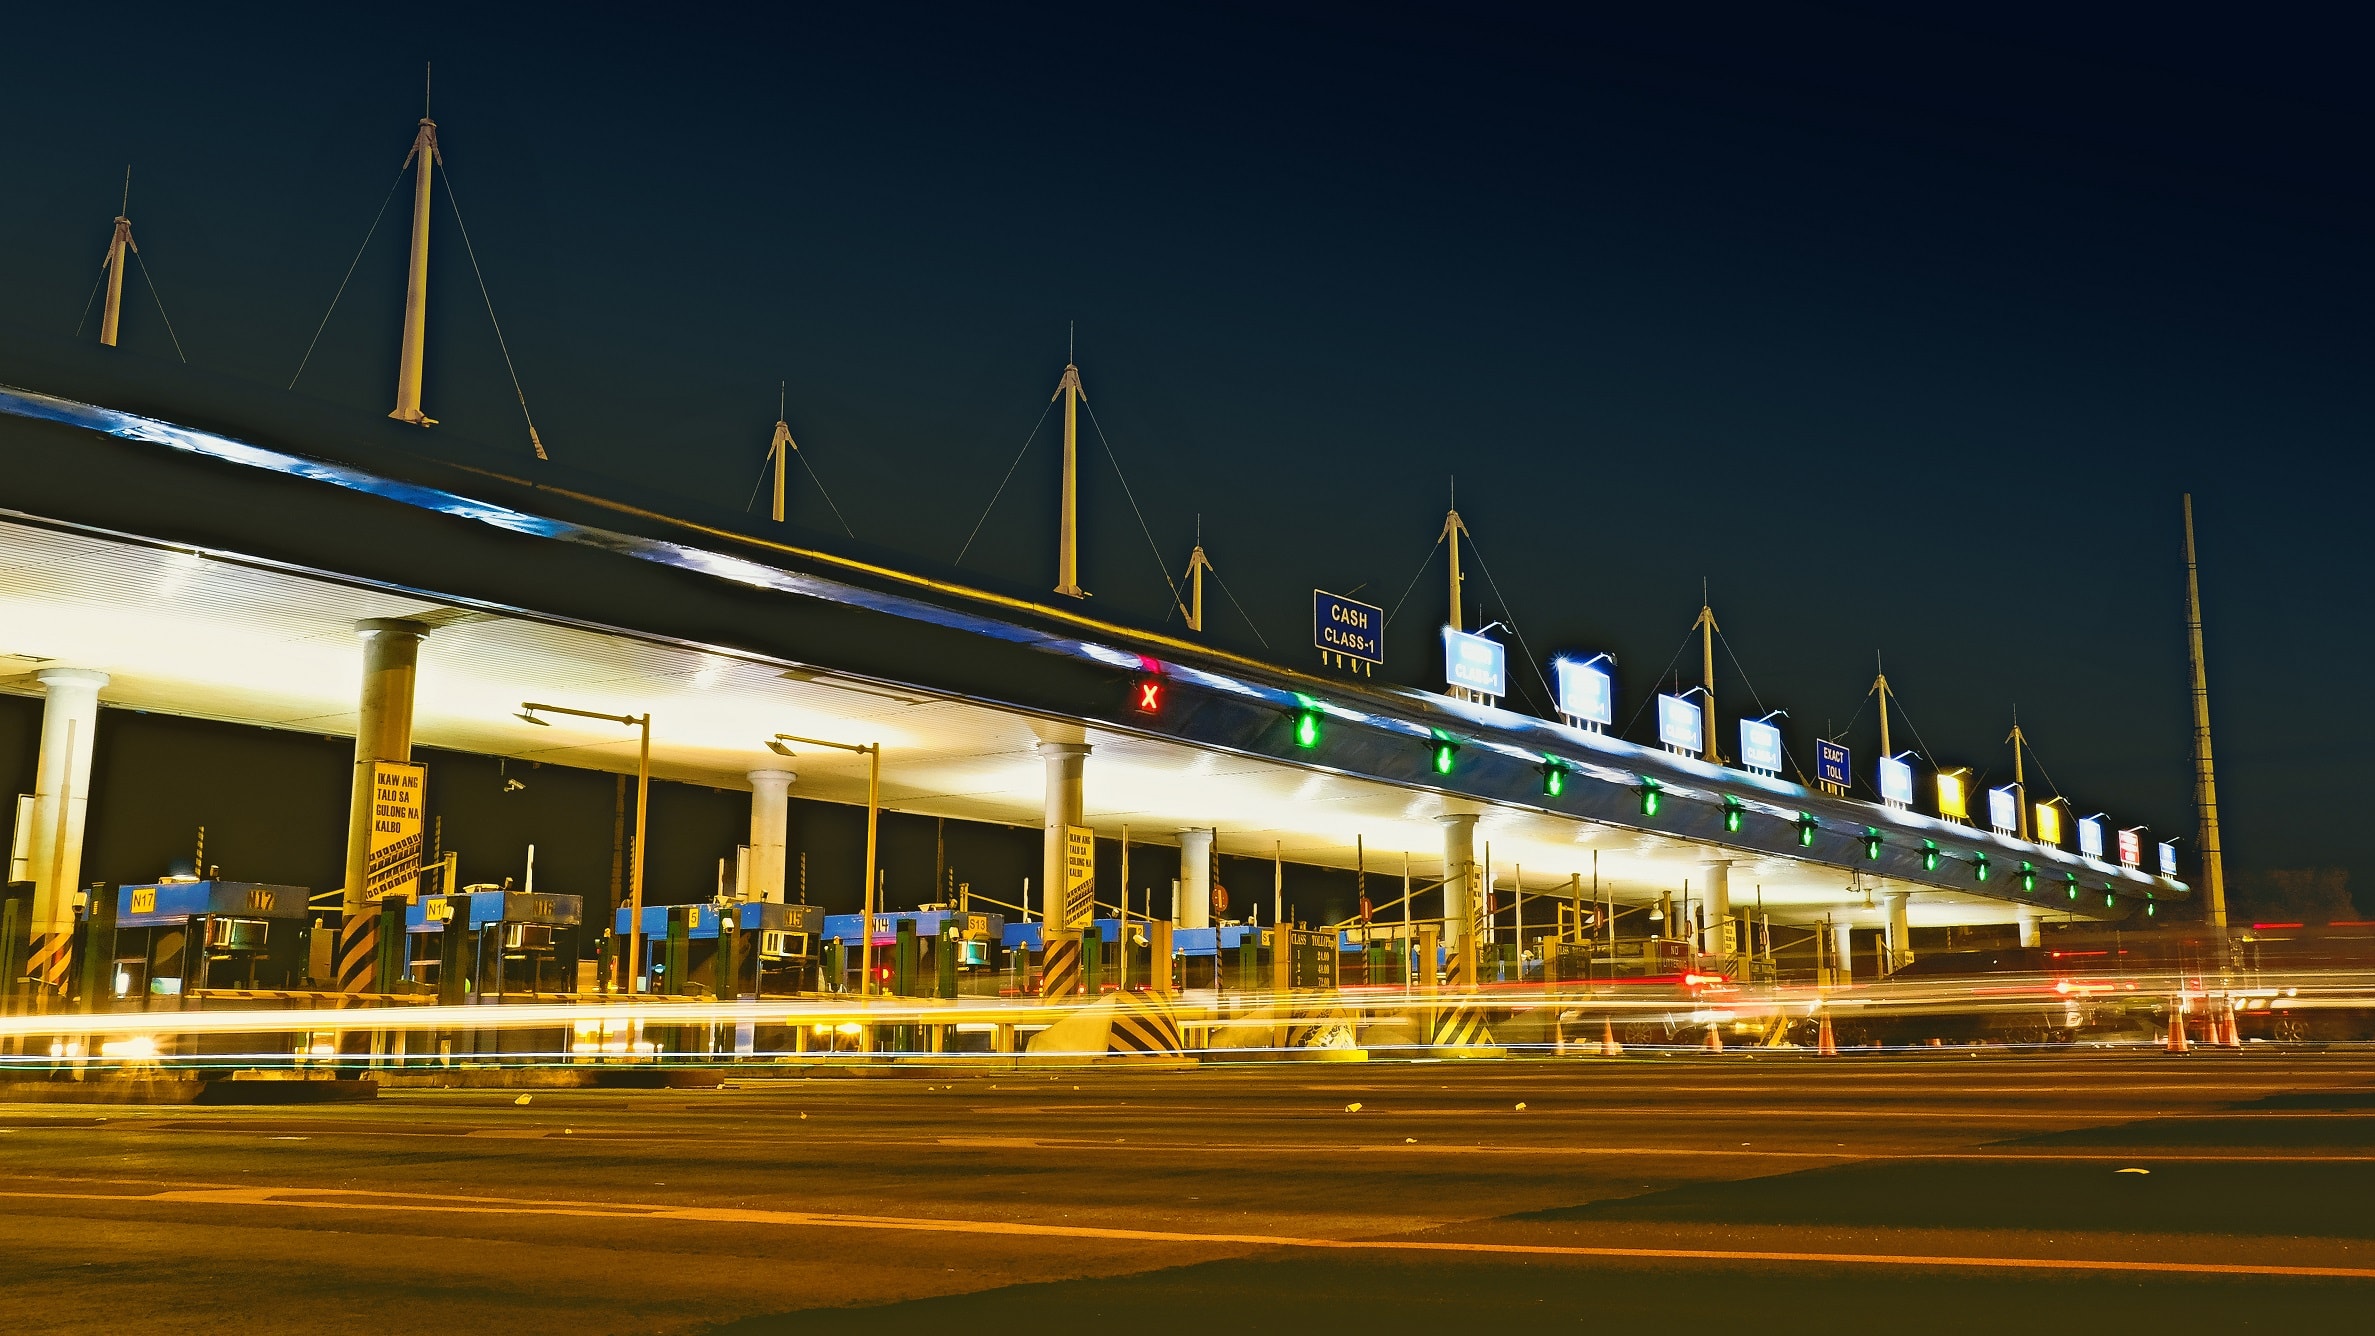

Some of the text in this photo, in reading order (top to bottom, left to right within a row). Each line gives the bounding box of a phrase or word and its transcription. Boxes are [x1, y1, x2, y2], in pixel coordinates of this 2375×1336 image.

[1331, 604, 1368, 630] CASH
[1324, 626, 1374, 654] CLASS-1
[1823, 746, 1844, 764] EXACT
[377, 772, 419, 788] IKAW ANG
[1826, 764, 1843, 780] TOLL
[377, 788, 410, 804] TALO SA
[376, 804, 420, 820] GULONG NA
[375, 819, 401, 834] KALBO
[133, 893, 154, 908] N17
[248, 890, 275, 912] N17
[969, 919, 986, 931] S13
[1291, 933, 1307, 946] CLASS
